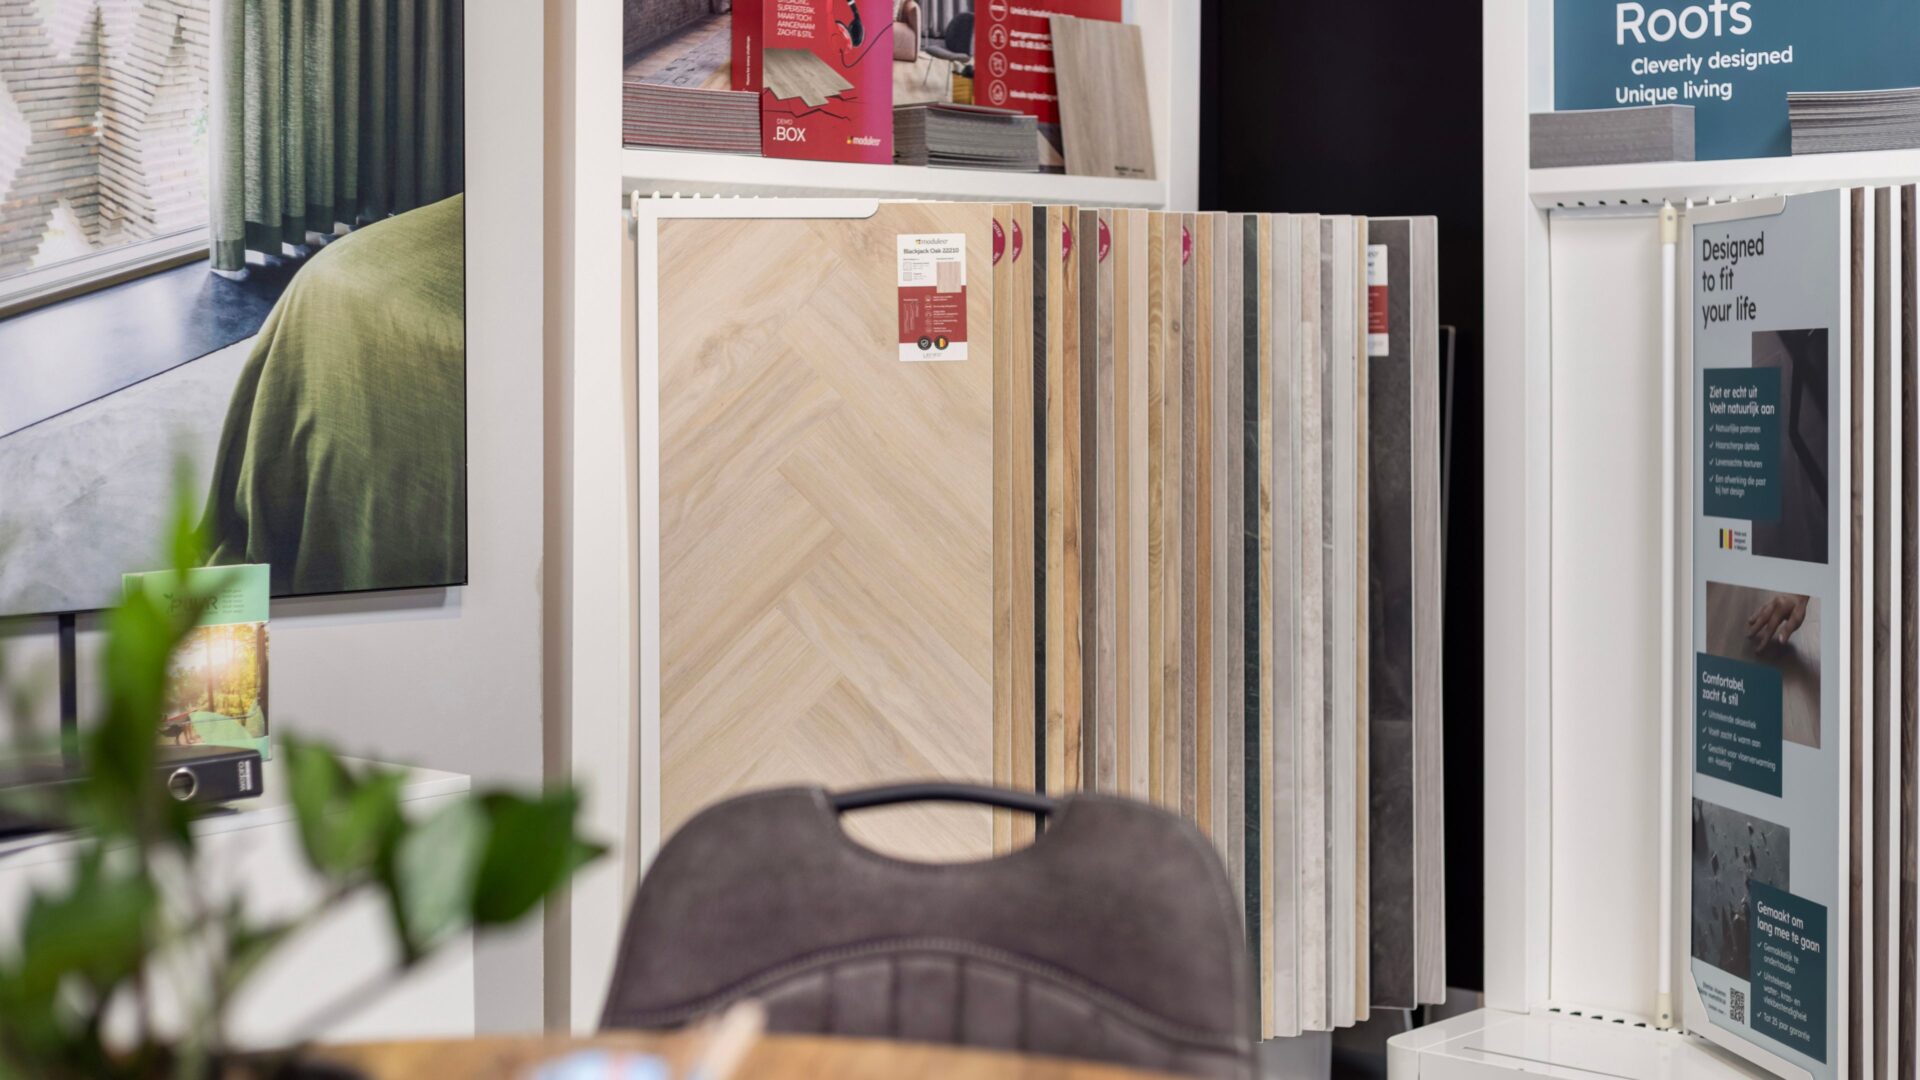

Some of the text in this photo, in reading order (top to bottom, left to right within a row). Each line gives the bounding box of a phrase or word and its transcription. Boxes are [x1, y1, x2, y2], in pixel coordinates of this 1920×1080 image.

[1616, 0, 1752, 45] Roots
[1631, 45, 1793, 75] Cleverly designed
[1616, 79, 1732, 105] Unique living
[773, 126, 806, 142] .BOX
[1702, 230, 1764, 265] Designed
[1702, 265, 1734, 292] to fit
[1702, 295, 1756, 330] your life
[1709, 385, 1758, 398] Ziet er echt uit
[1709, 401, 1775, 417] Voelt natuurlijk aan
[1702, 671, 1745, 694] Comfortabel,
[1702, 688, 1739, 706] zacht & stil
[1757, 900, 1804, 930] Gemaakt om
[1757, 915, 1820, 953] lang mee te gaan
